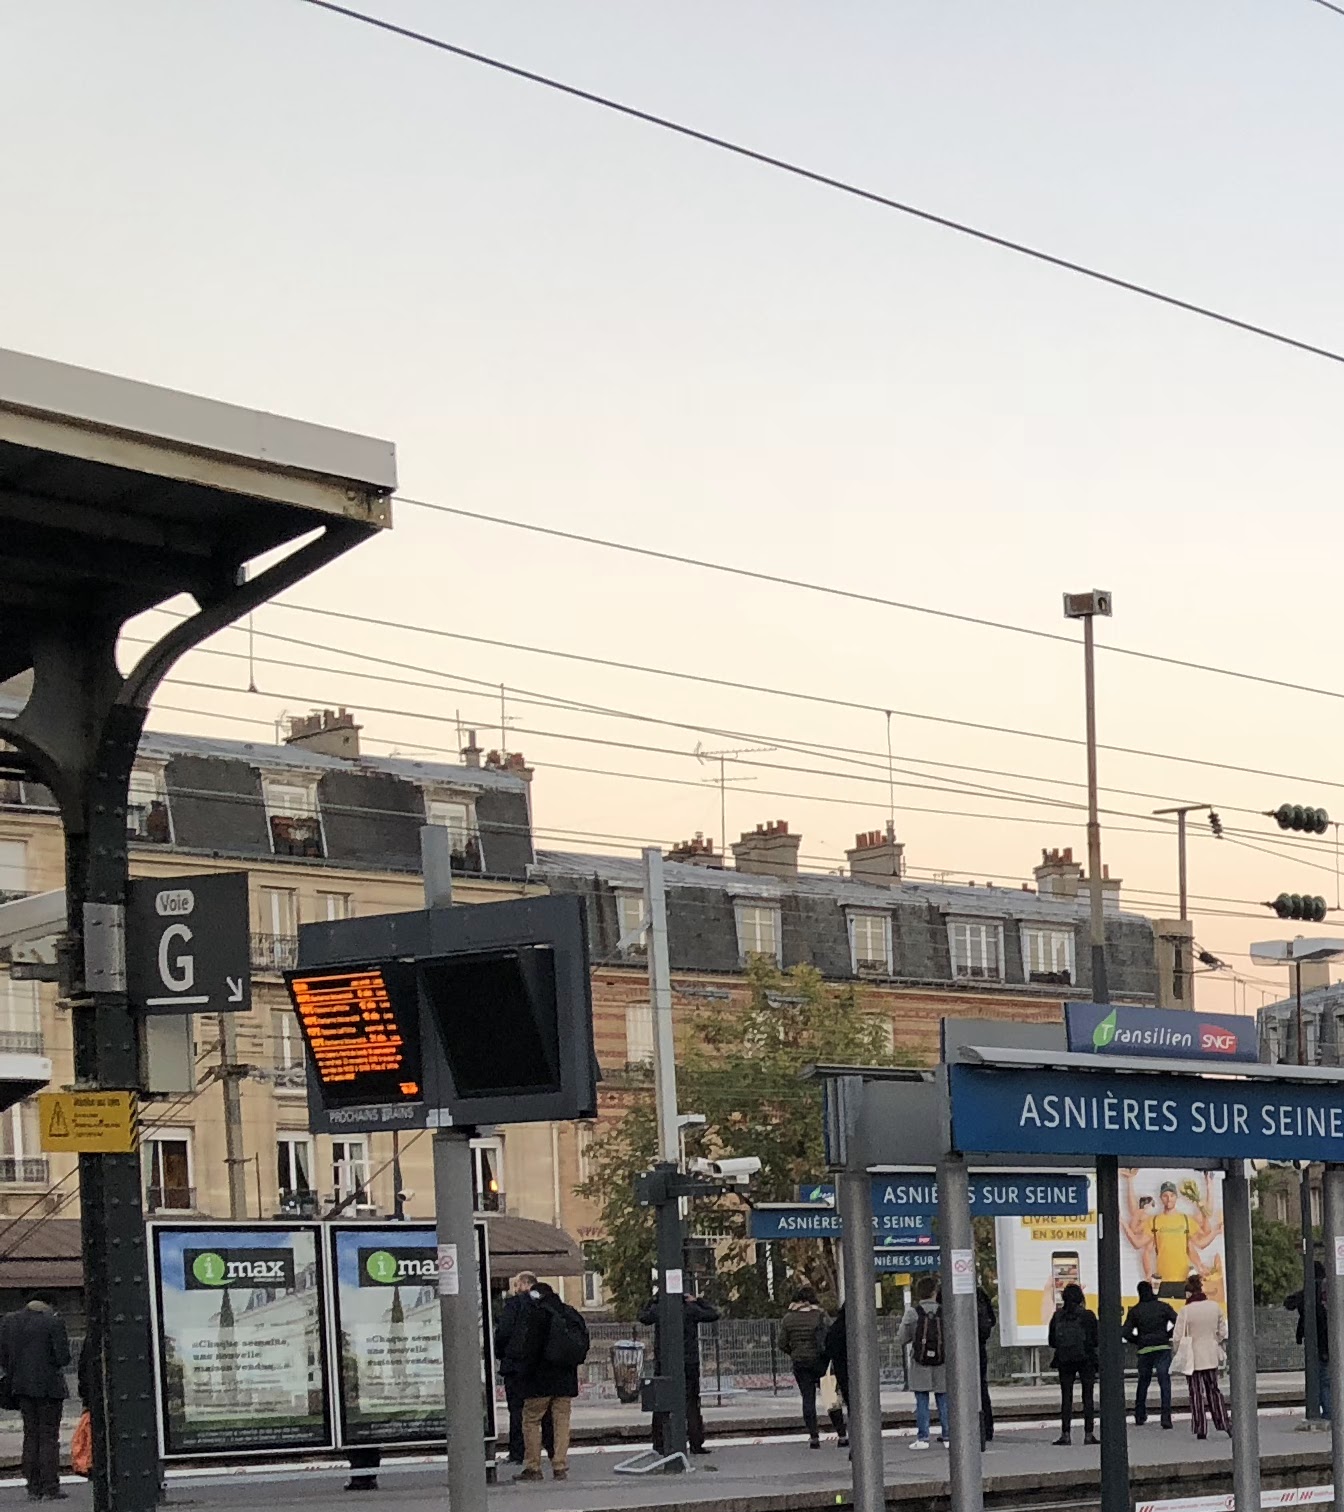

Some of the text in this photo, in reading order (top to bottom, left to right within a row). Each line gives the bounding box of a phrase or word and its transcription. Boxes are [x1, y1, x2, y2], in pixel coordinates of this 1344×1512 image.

[159, 893, 190, 912] Voie
[158, 923, 194, 992] G
[1098, 1022, 1236, 1050] Transilien SNCF
[1019, 1090, 1344, 1138] ASNIÈRES SUR SEINE
[883, 1181, 1078, 1205] ASNIÈS SUR SEINE
[883, 1215, 924, 1229] SEINE
[1032, 1230, 1087, 1240] EN 30 MIN
[914, 1255, 934, 1266] SUR
